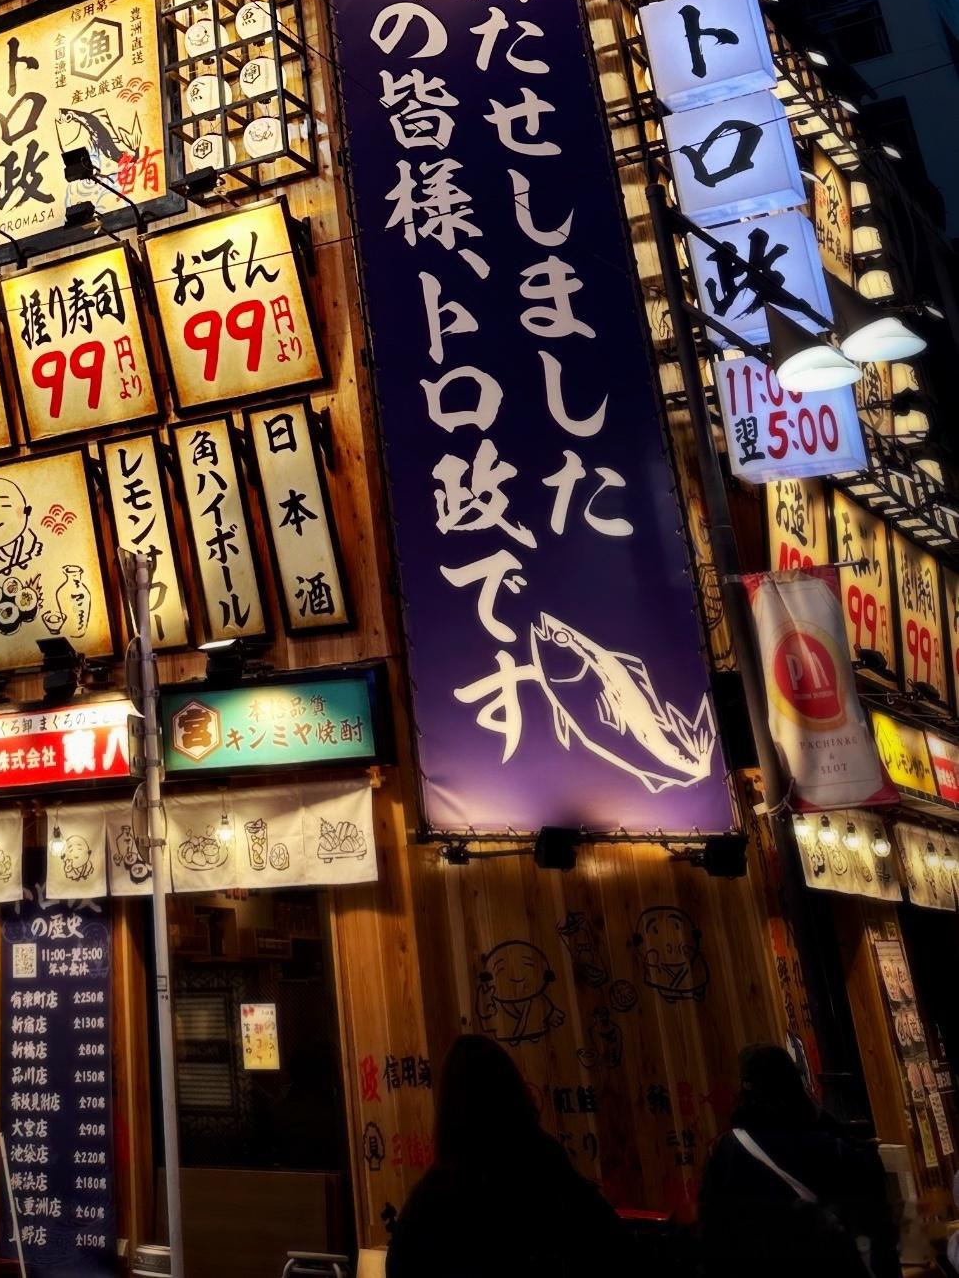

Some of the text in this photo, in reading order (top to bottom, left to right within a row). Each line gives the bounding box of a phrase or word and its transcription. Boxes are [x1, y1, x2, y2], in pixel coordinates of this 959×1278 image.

[54, 33, 68, 90] 全国漁連
[79, 29, 113, 68] 漁
[130, 7, 144, 66] 豊洲直送
[70, 75, 125, 106] 産地厳選
[116, 146, 163, 202] 鮪
[678, 4, 811, 322] トロ政
[170, 231, 281, 306] おでん
[20, 268, 127, 350] 握り寿司
[183, 299, 267, 382] 99
[31, 340, 106, 419] 99
[726, 364, 804, 416] 11:0
[735, 405, 838, 466] 翌5:00
[189, 430, 251, 630] 角ハイボール
[263, 413, 336, 618] 日本酒
[178, 709, 215, 749] 宮
[225, 715, 365, 752] キンミヤ焼酎
[248, 694, 327, 721] 本格品質
[820, 763, 849, 775] SLOT
[30, 914, 84, 939] の歴史
[11, 1015, 48, 1034] 新宿店
[11, 1066, 48, 1086] 品川店
[10, 1144, 48, 1164] 池袋店
[11, 1118, 48, 1138] 大宮店
